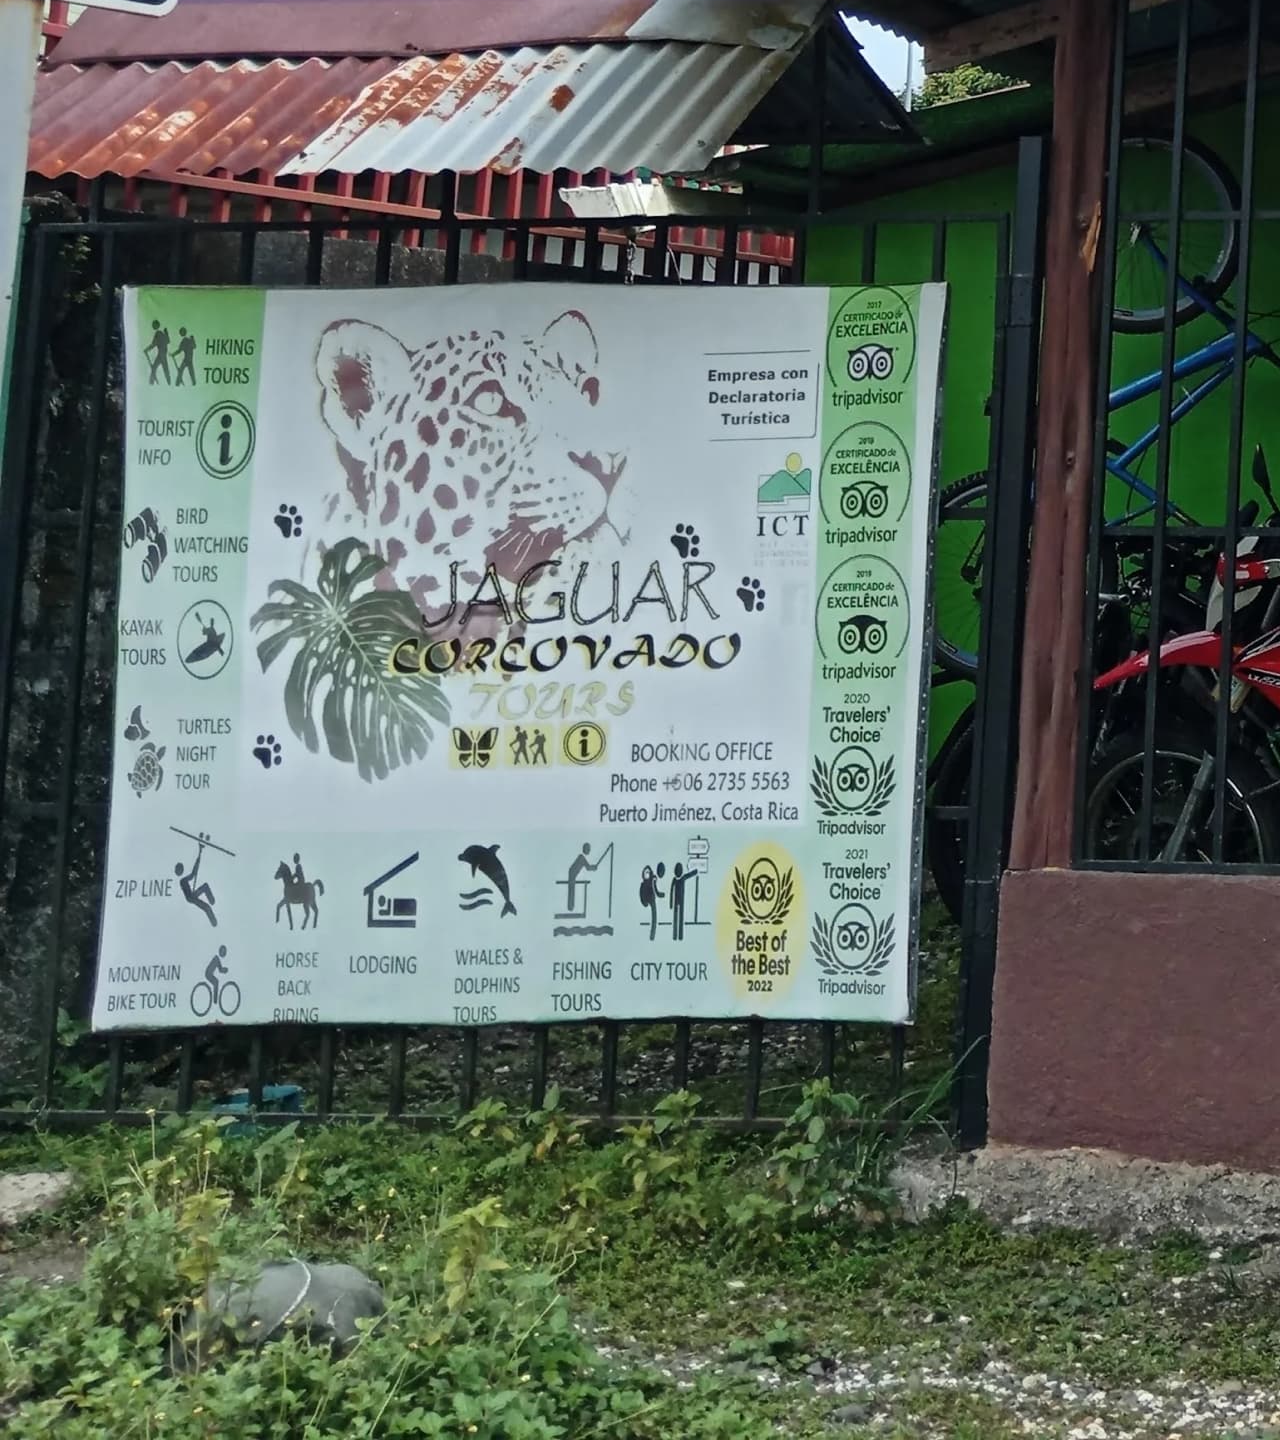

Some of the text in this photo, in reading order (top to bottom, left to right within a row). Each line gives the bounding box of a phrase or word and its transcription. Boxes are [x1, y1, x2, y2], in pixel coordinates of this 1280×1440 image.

[204, 367, 250, 385] TOURS
[707, 367, 809, 385] Empresa con
[708, 388, 806, 406] Declaratoria
[832, 389, 904, 410] tripadvisor
[721, 411, 790, 426] Turística
[137, 420, 195, 437] TOURIST
[138, 449, 172, 466] INFO
[176, 508, 209, 525] BIRD
[174, 536, 249, 554] WATCHING
[825, 526, 898, 548] tripadvisor
[172, 565, 218, 583] TOURS
[421, 559, 721, 629] JAGUAR
[120, 619, 163, 637] KAYAK
[120, 648, 167, 665] TOURS
[388, 632, 742, 676] CORCOVADO
[822, 662, 896, 683] tripadvisor
[177, 718, 232, 735] TURTLES
[829, 726, 881, 743] Choice
[176, 745, 217, 762] NIGHT
[631, 741, 773, 763] BOOKING OFFICE
[175, 773, 211, 790] TOUR
[610, 773, 657, 792] Phone
[706, 772, 747, 791] 2735
[751, 772, 790, 791] 5563
[600, 803, 648, 823] Puerto
[721, 802, 764, 822] Costa
[767, 801, 798, 820] Rica
[817, 820, 886, 837] Tripadvisor
[115, 879, 174, 899] ZIP LINE
[829, 882, 881, 901] Choice
[736, 930, 788, 952] Best of
[275, 951, 319, 969] HORSE
[349, 956, 417, 974] LODGING
[455, 948, 510, 966] WHALES
[731, 955, 791, 976] the Best
[108, 964, 181, 984] MOUNTAIN
[552, 961, 613, 981] FISHING
[630, 962, 708, 981] CITY TOUR
[278, 979, 311, 996] BACK
[454, 977, 521, 994] DOLPHINS
[818, 979, 886, 996] Tripadvisor
[107, 992, 177, 1012] BIKE TOUR
[551, 994, 602, 1012] TOURS
[453, 1005, 497, 1023] TOURS
